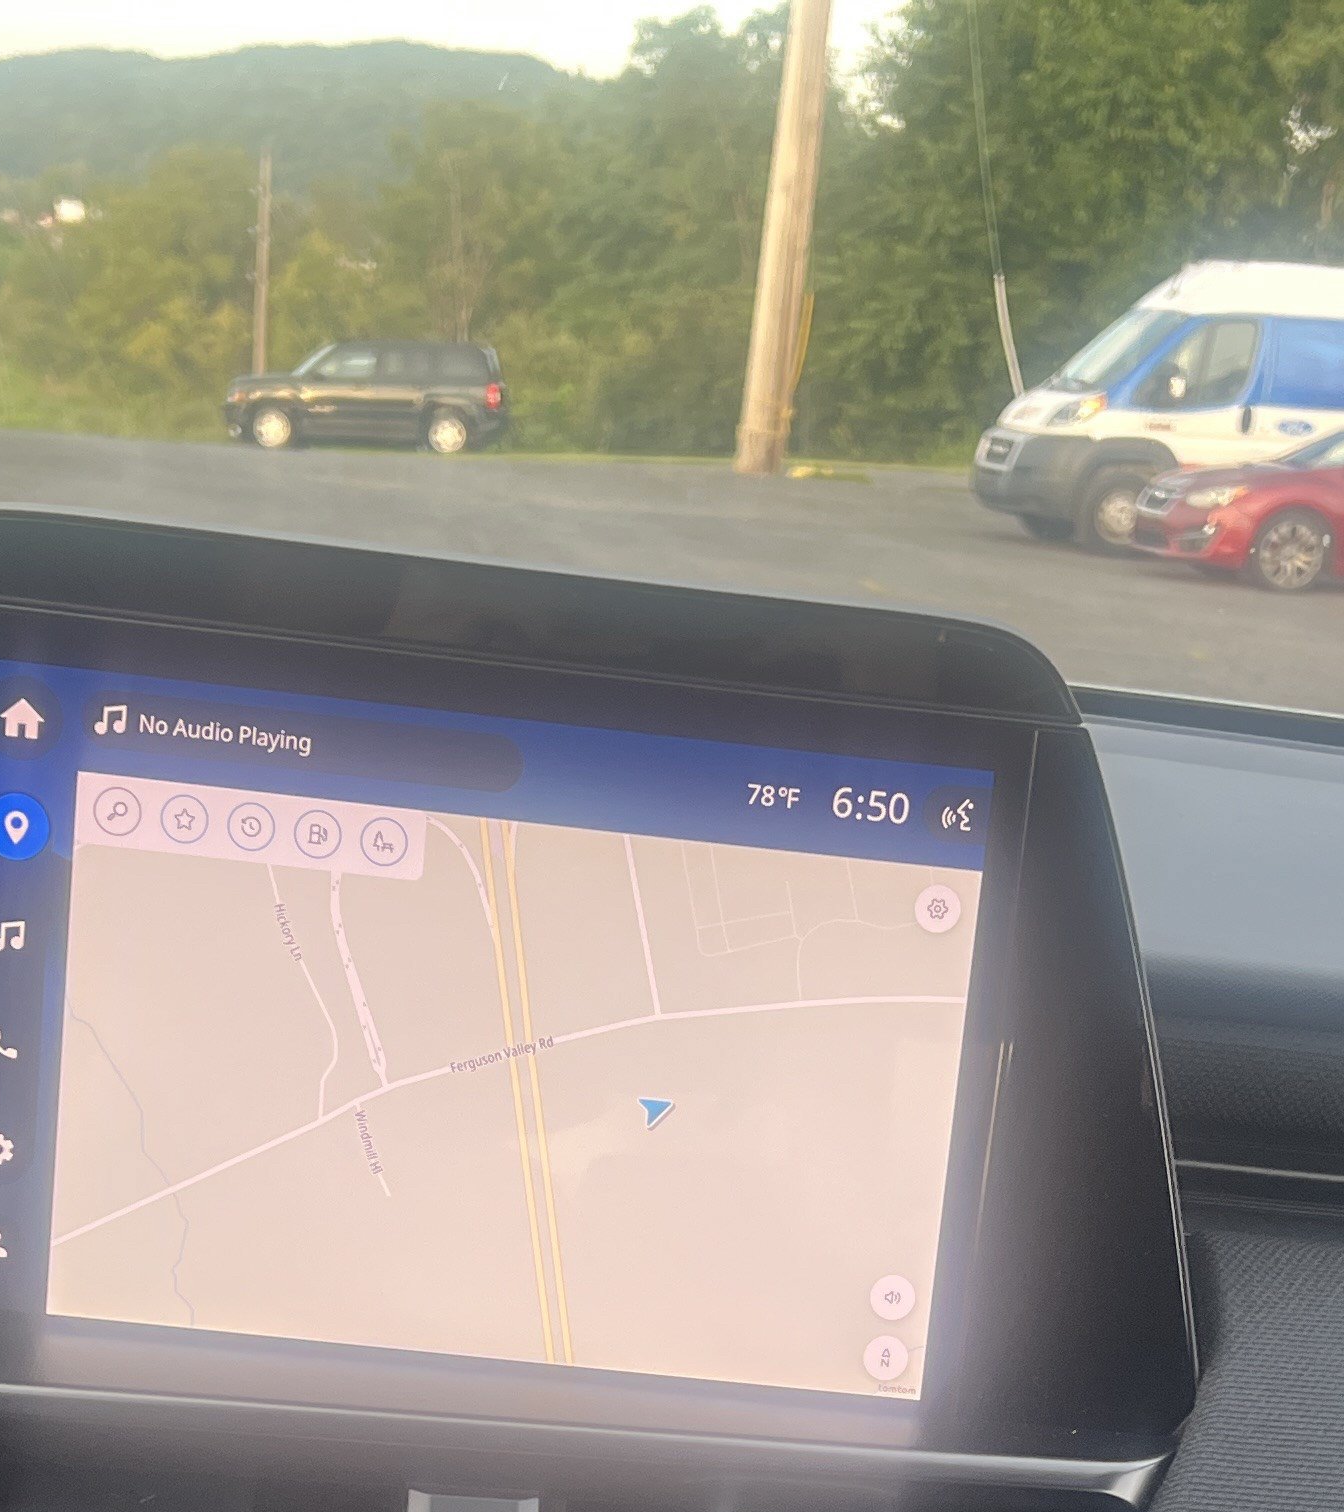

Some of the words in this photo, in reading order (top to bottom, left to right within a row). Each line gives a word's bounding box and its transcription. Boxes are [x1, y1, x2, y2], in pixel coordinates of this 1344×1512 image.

[139, 714, 168, 737] No
[172, 717, 234, 745] Audio
[239, 725, 313, 756] Playing
[747, 784, 801, 809] 78°F
[832, 786, 911, 825] 6:50
[275, 904, 296, 946] Hickory
[450, 1052, 502, 1073] Ferguson
[503, 1042, 537, 1059] Valley
[538, 1036, 554, 1050] Rd
[355, 1111, 377, 1162] Windmill
[878, 1384, 917, 1395] tomtom
